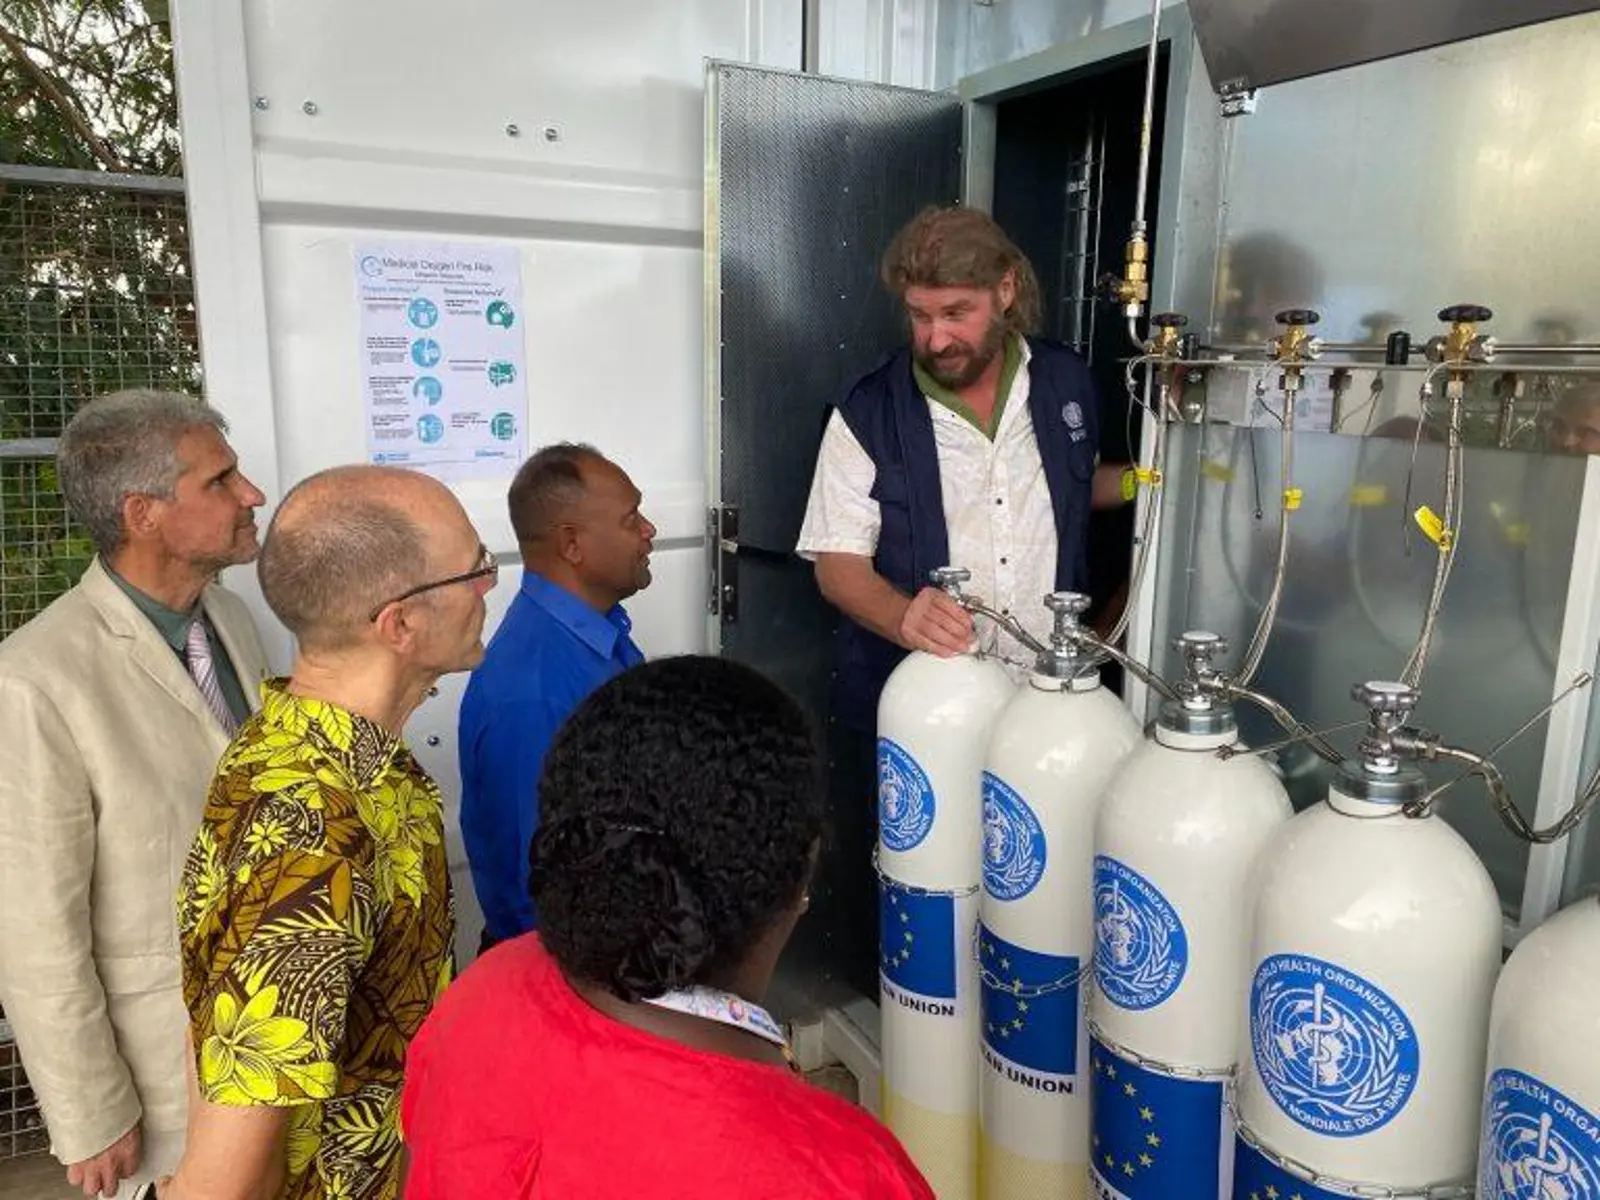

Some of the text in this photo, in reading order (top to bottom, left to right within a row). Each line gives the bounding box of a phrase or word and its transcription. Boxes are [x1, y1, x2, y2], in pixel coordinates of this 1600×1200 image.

[1118, 867, 1179, 932] ORGANIZATION
[899, 993, 955, 1016] UNION
[1277, 959, 1322, 977] HEALTH
[1324, 968, 1409, 1041] ORGANIZATION
[1008, 1067, 1073, 1094] UNION
[1289, 1103, 1354, 1132] MONDIALE
